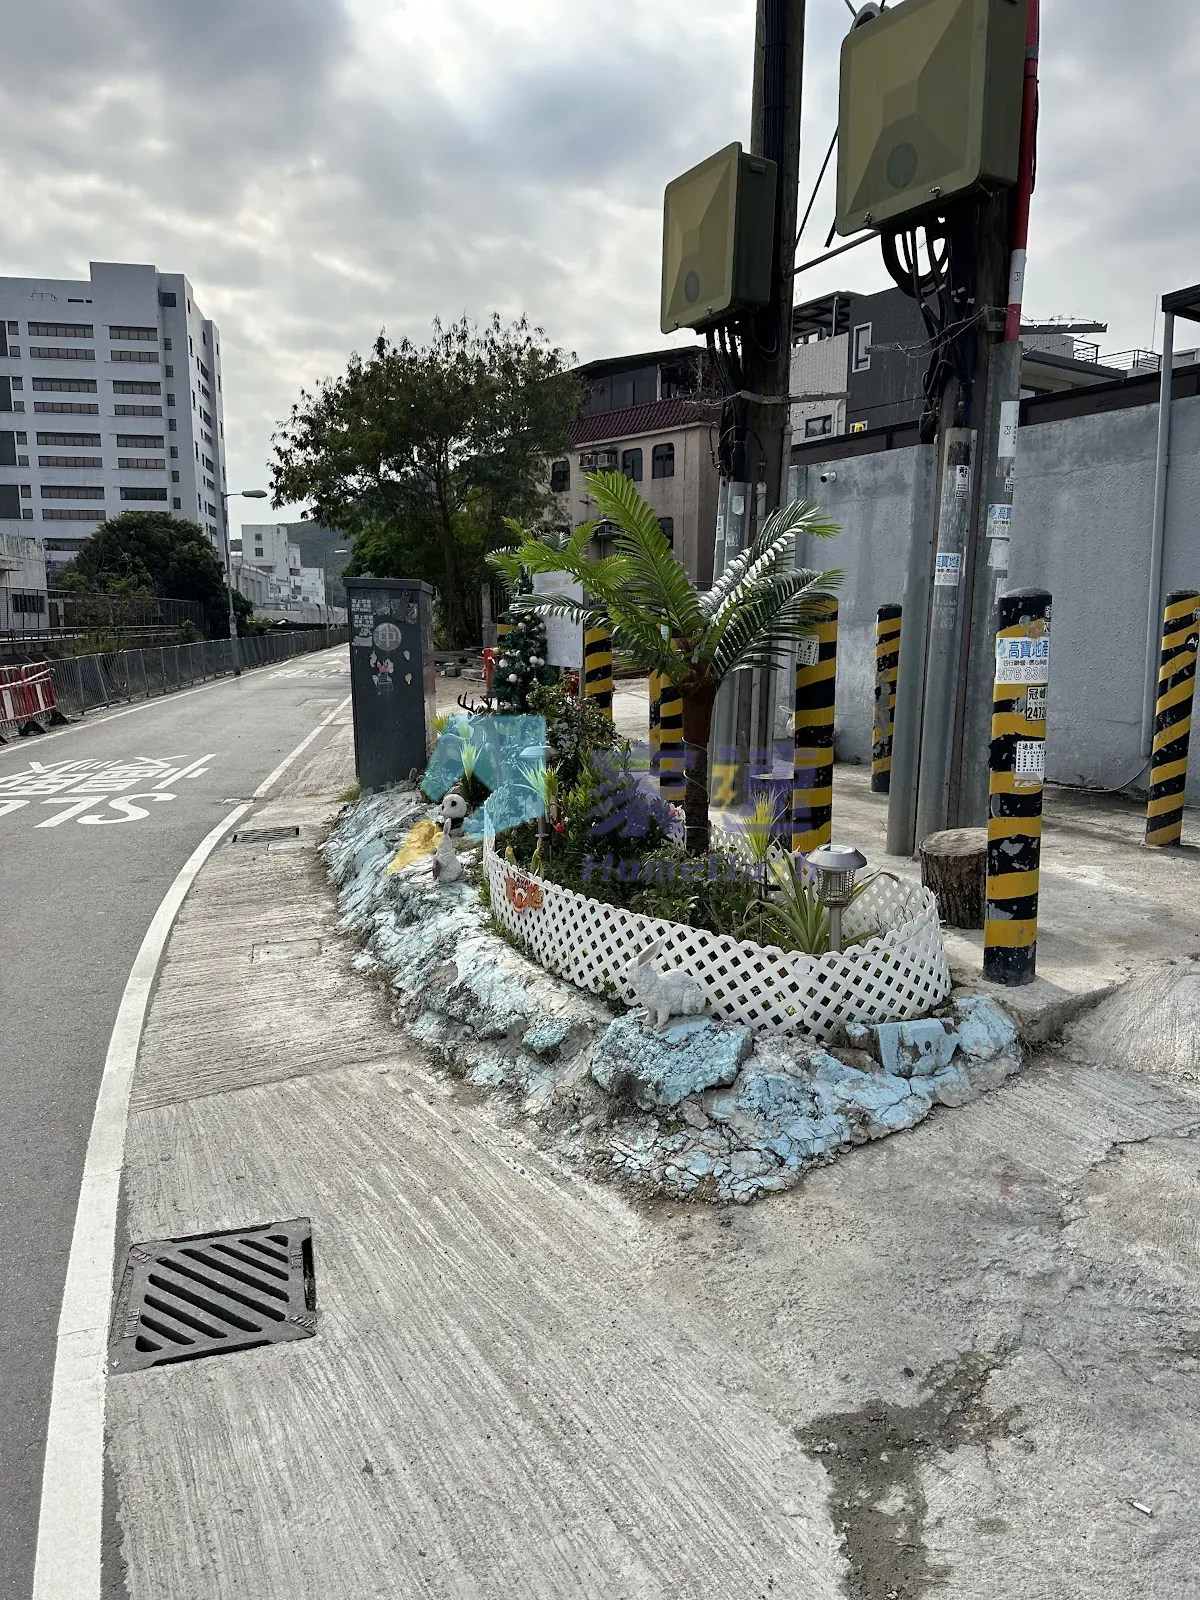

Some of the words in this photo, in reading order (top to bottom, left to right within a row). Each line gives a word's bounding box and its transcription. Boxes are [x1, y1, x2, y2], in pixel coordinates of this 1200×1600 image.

[1004, 425, 1011, 436] P3
[379, 626, 397, 648] 中
[1008, 640, 1049, 659] 高寶地產
[997, 667, 1022, 681] 2476
